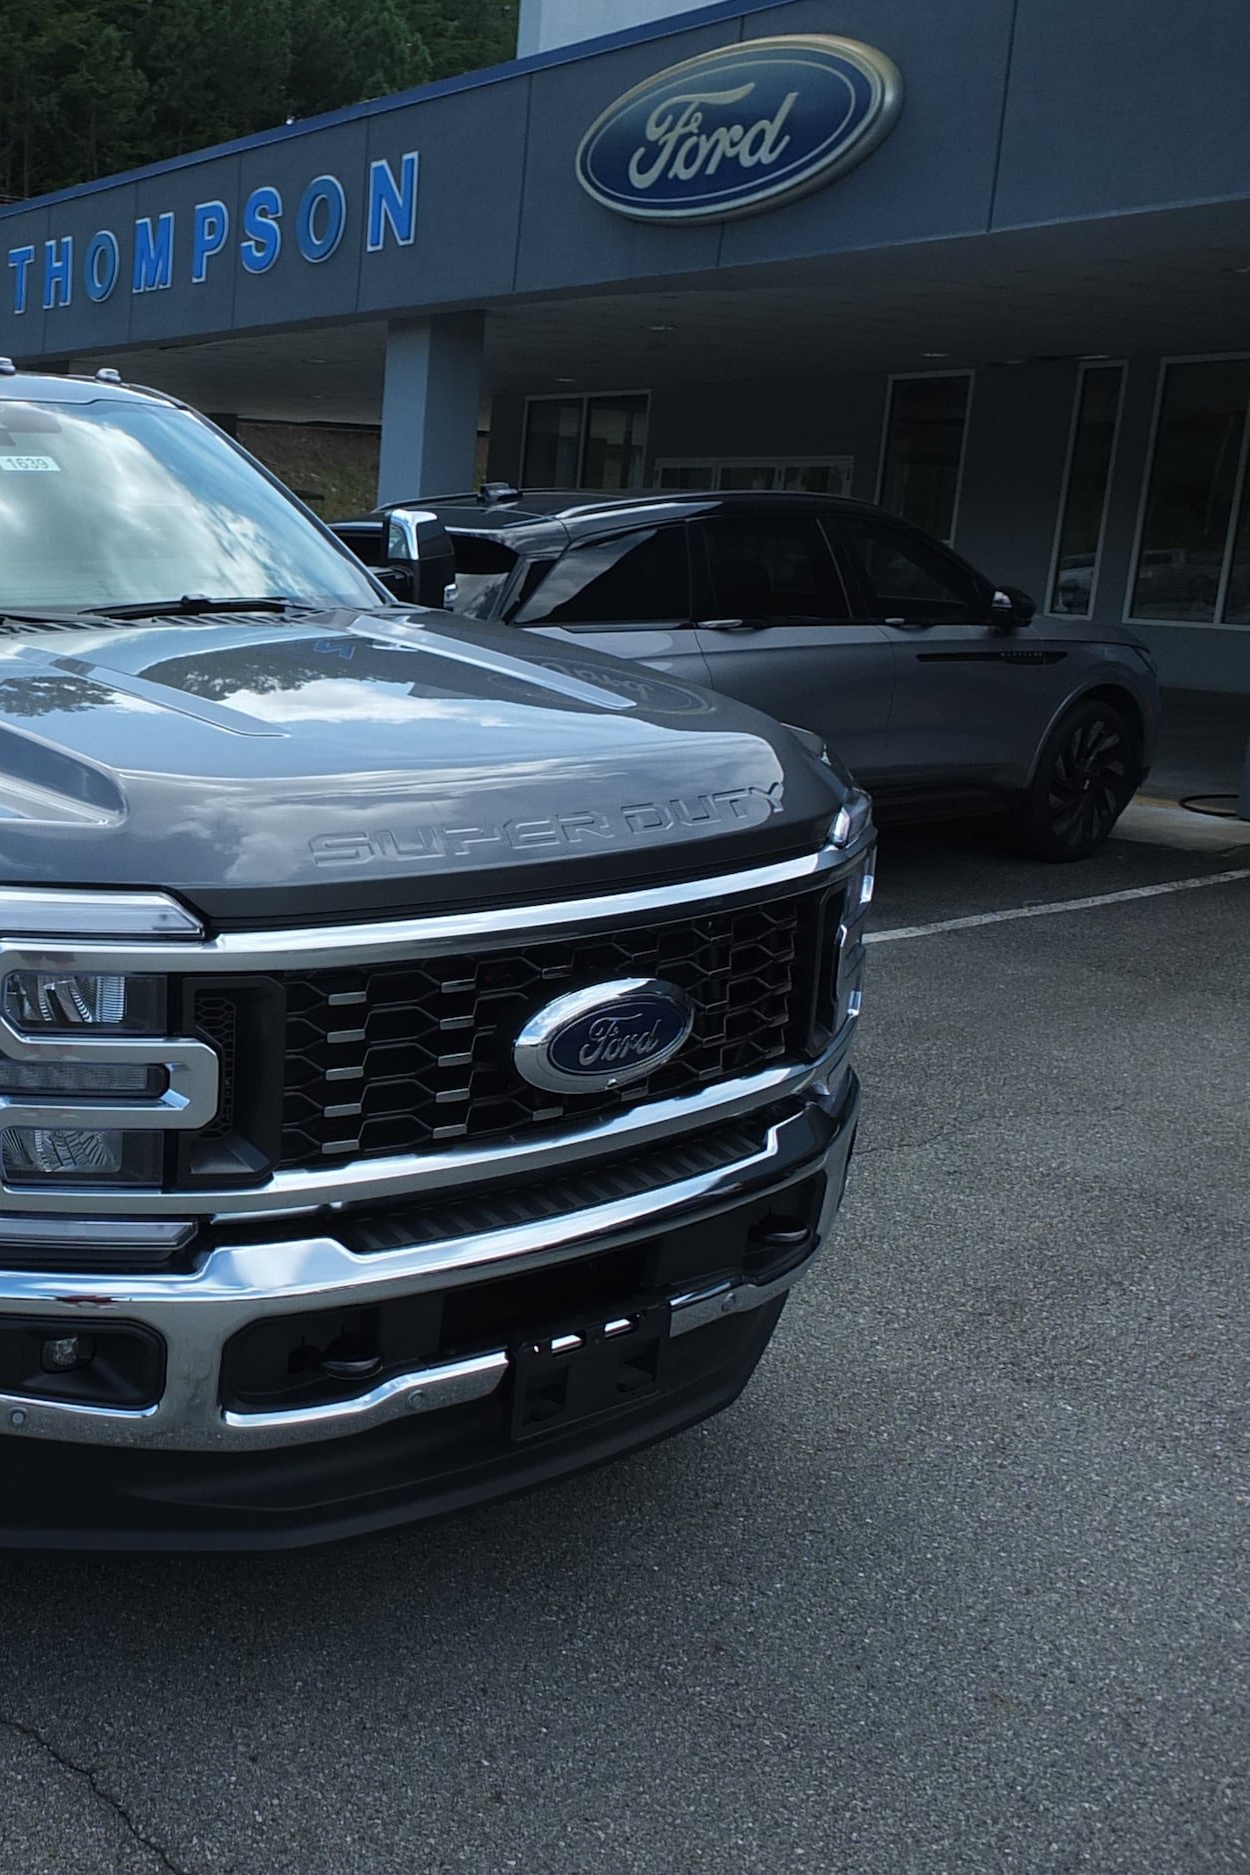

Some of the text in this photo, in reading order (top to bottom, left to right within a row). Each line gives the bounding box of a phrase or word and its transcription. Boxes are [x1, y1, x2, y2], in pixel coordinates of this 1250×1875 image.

[628, 82, 799, 189] Ford
[8, 150, 420, 316] THOMPSON
[5, 457, 49, 469] 1639
[309, 781, 785, 869] SUPER DUTY
[578, 1012, 663, 1066] Ford
